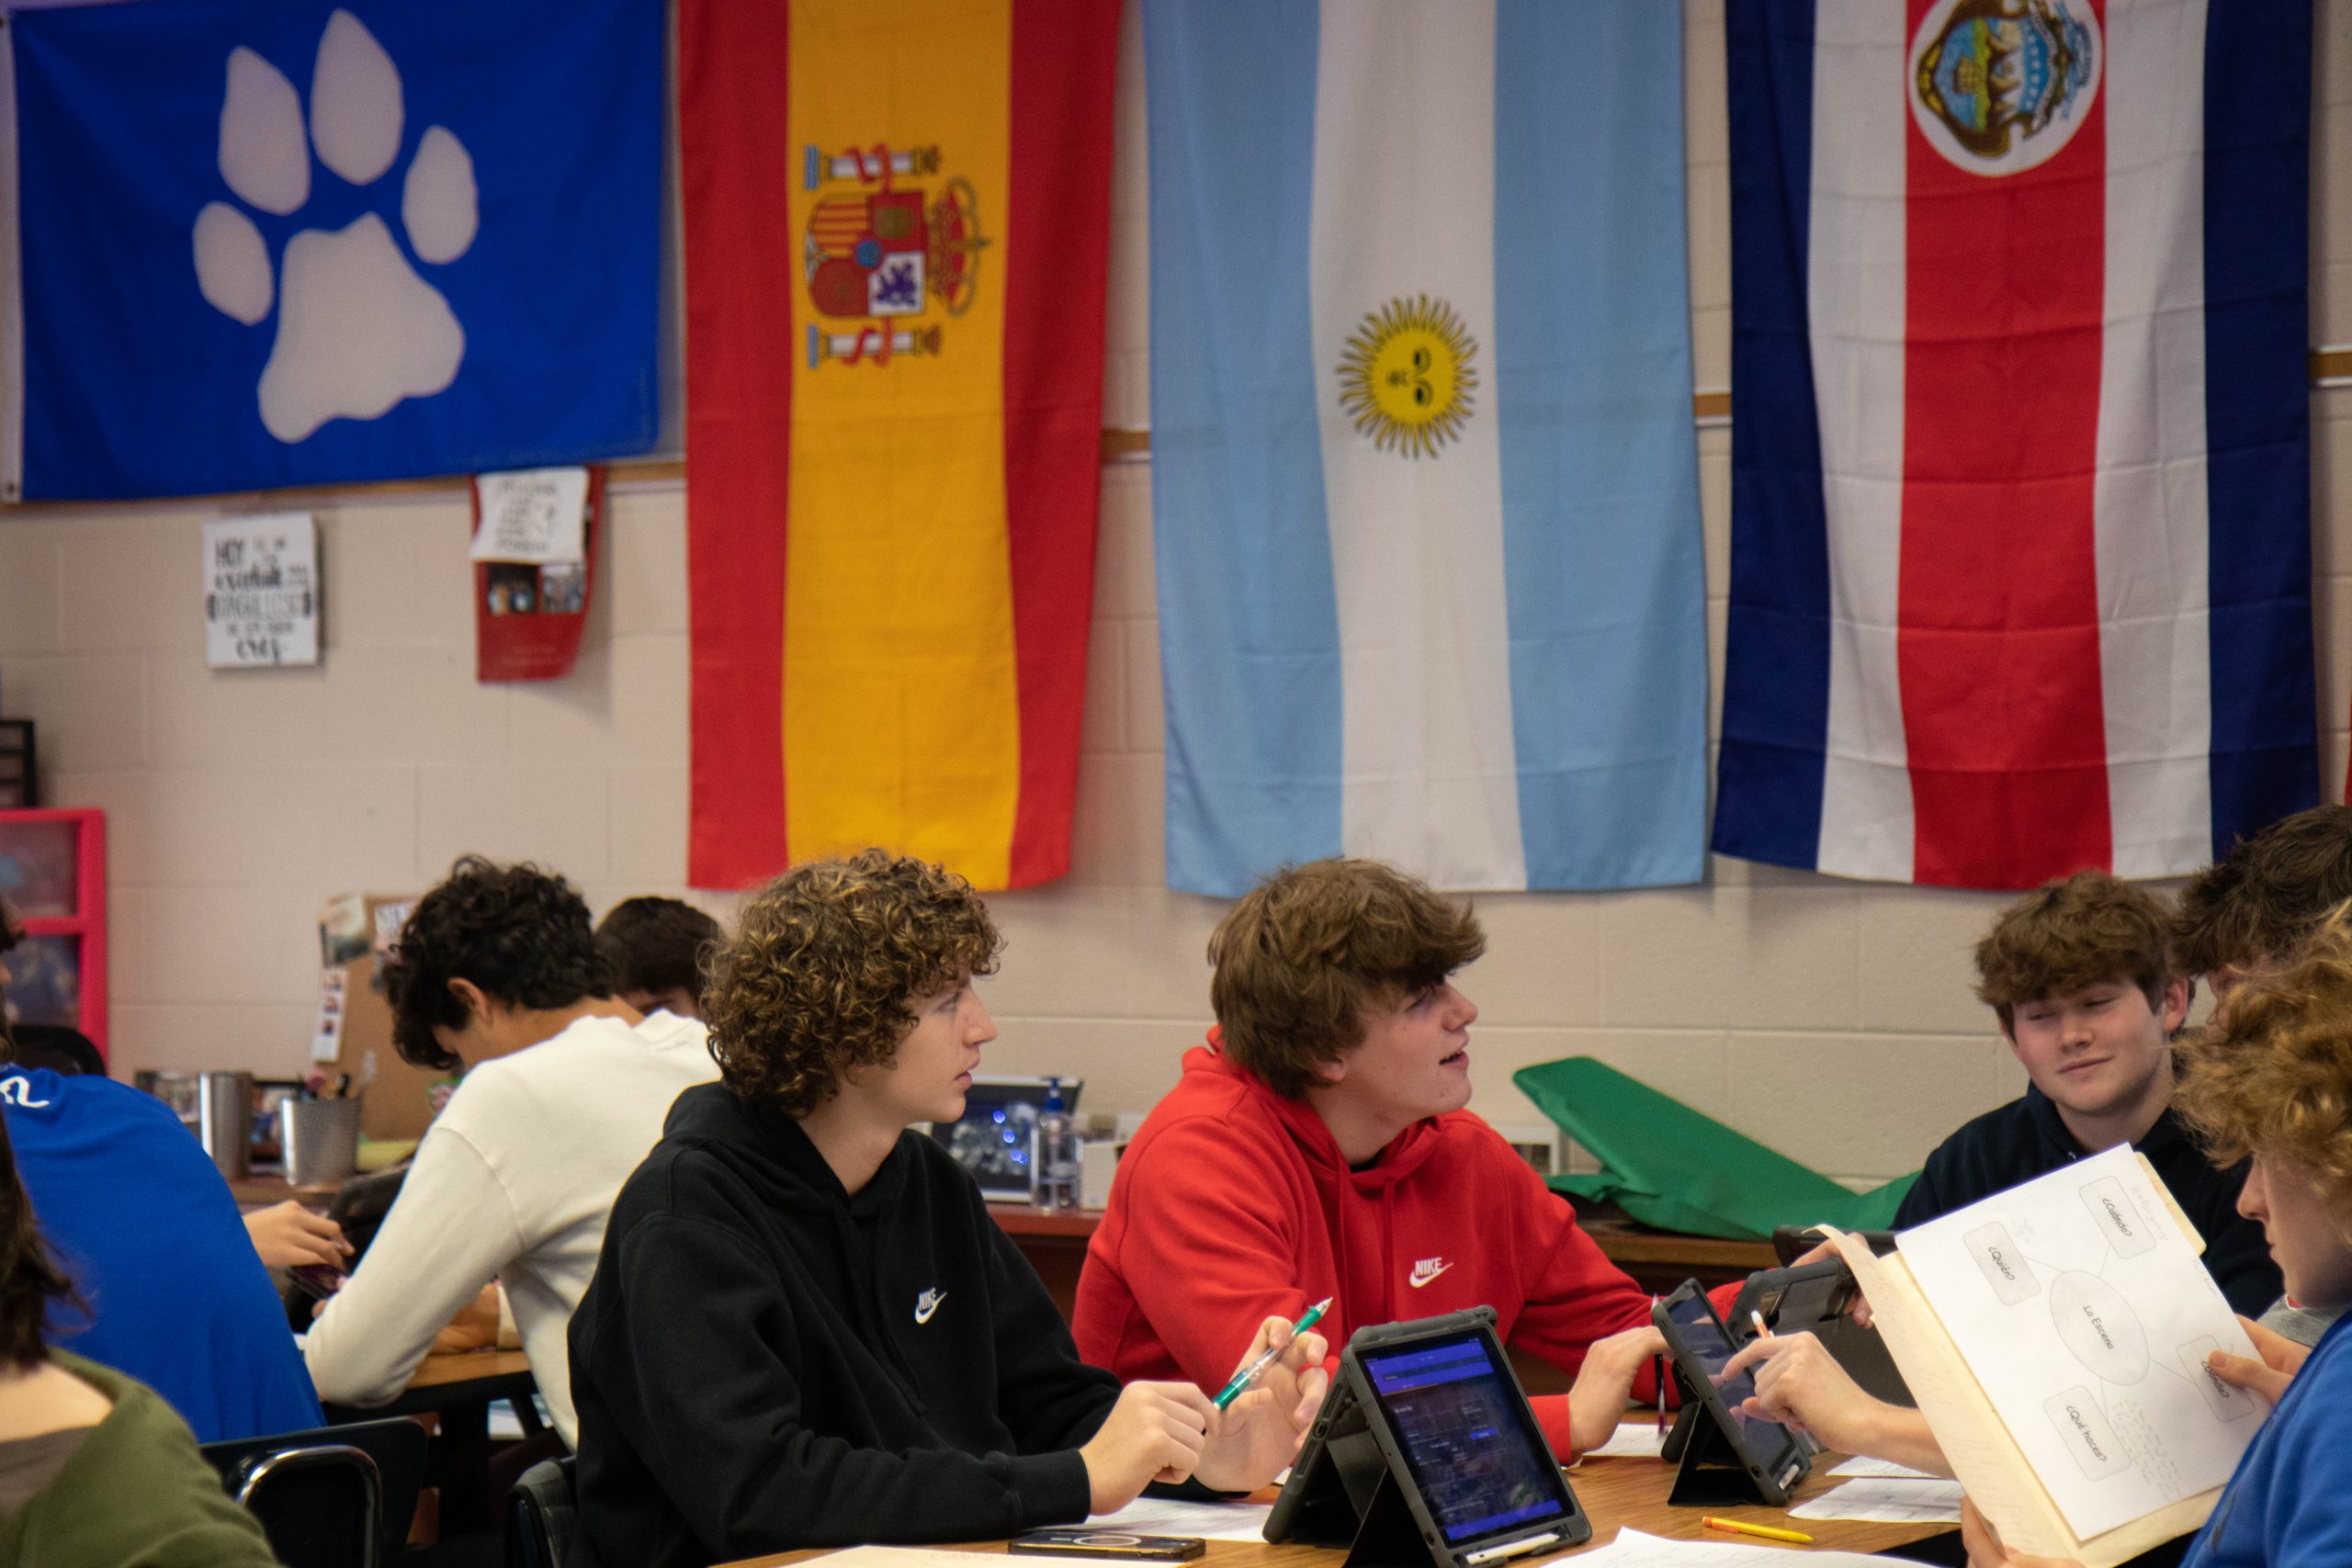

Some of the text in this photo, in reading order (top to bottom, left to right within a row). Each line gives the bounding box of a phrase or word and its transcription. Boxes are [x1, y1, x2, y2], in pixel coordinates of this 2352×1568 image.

[2102, 1198, 2132, 1237] ¿Cuándo?
[1415, 1257, 1442, 1277] NIKE
[1988, 1246, 2015, 1281] ¿Quién?
[919, 1287, 936, 1311] NIKE
[2083, 1304, 2114, 1350] La Escena
[2066, 1405, 2107, 1461] ¿Qué haces?
